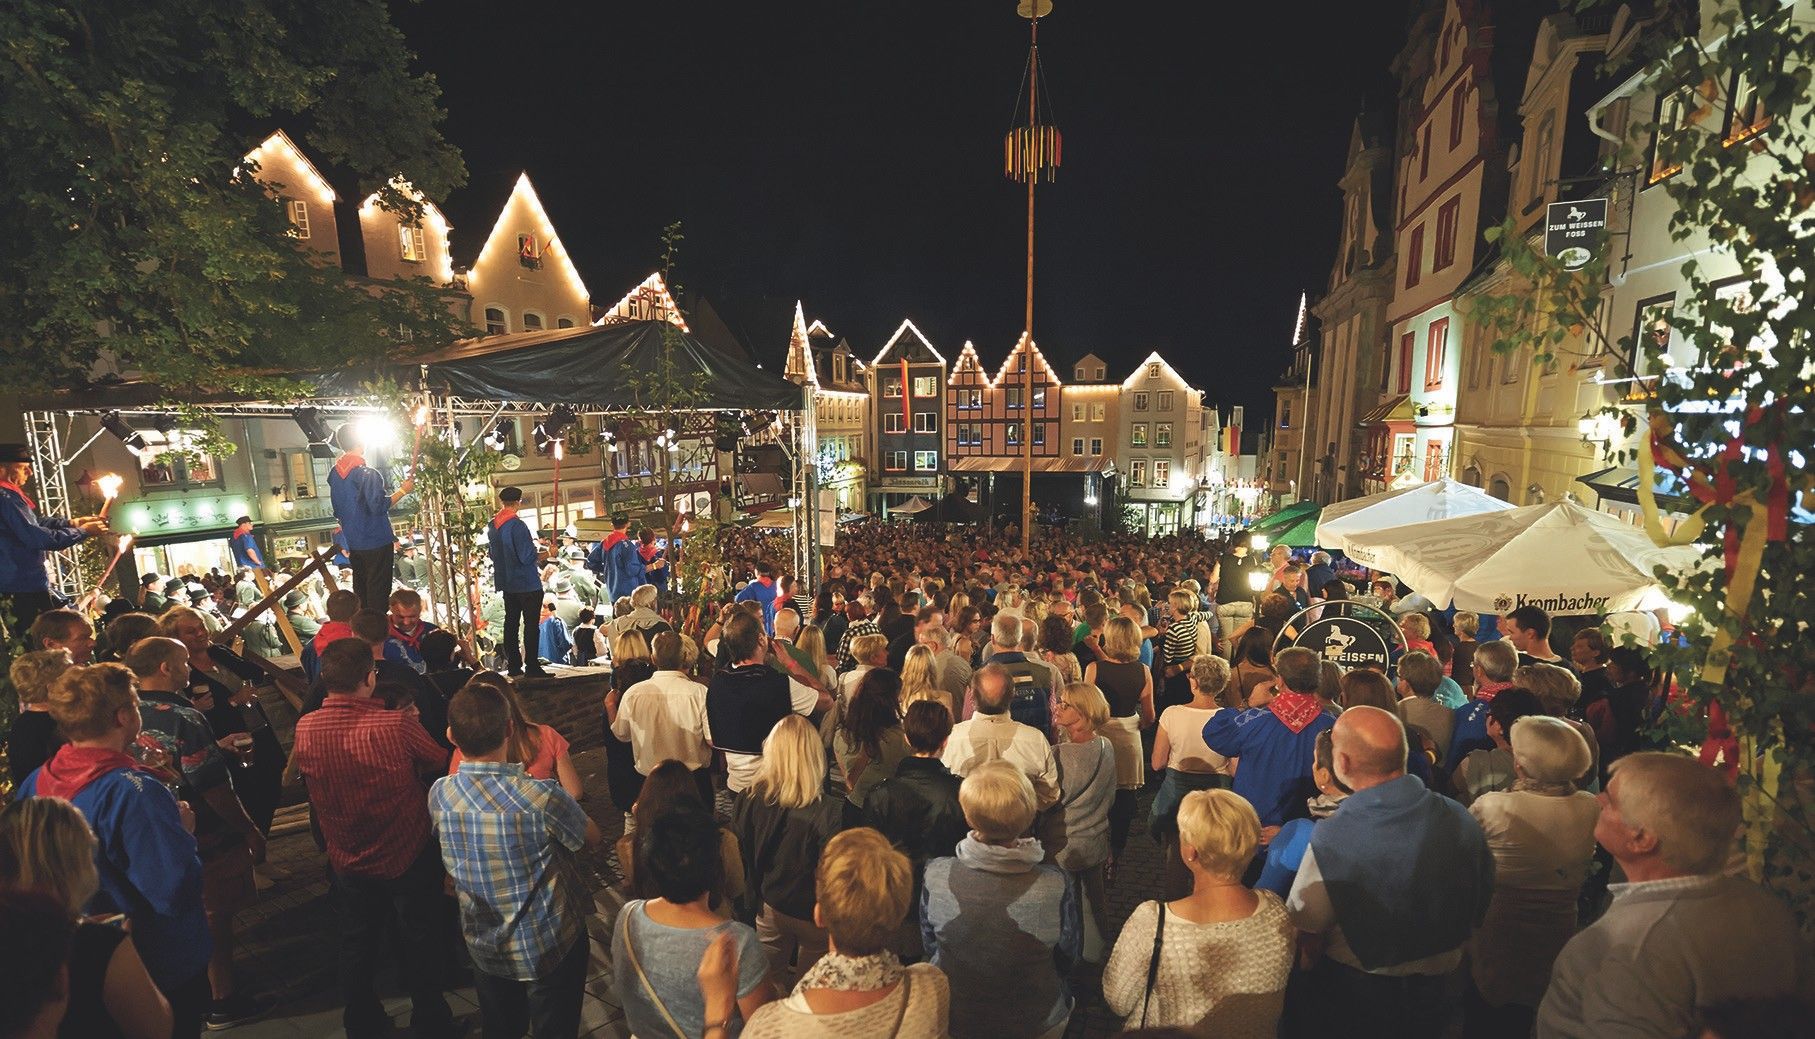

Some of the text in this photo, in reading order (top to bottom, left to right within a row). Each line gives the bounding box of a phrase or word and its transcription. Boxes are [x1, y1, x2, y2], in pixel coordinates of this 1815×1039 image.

[1549, 220, 1604, 231] ZUM WEISSEN
[1565, 230, 1586, 238] FOSS
[1516, 592, 1610, 611] Krombacher
